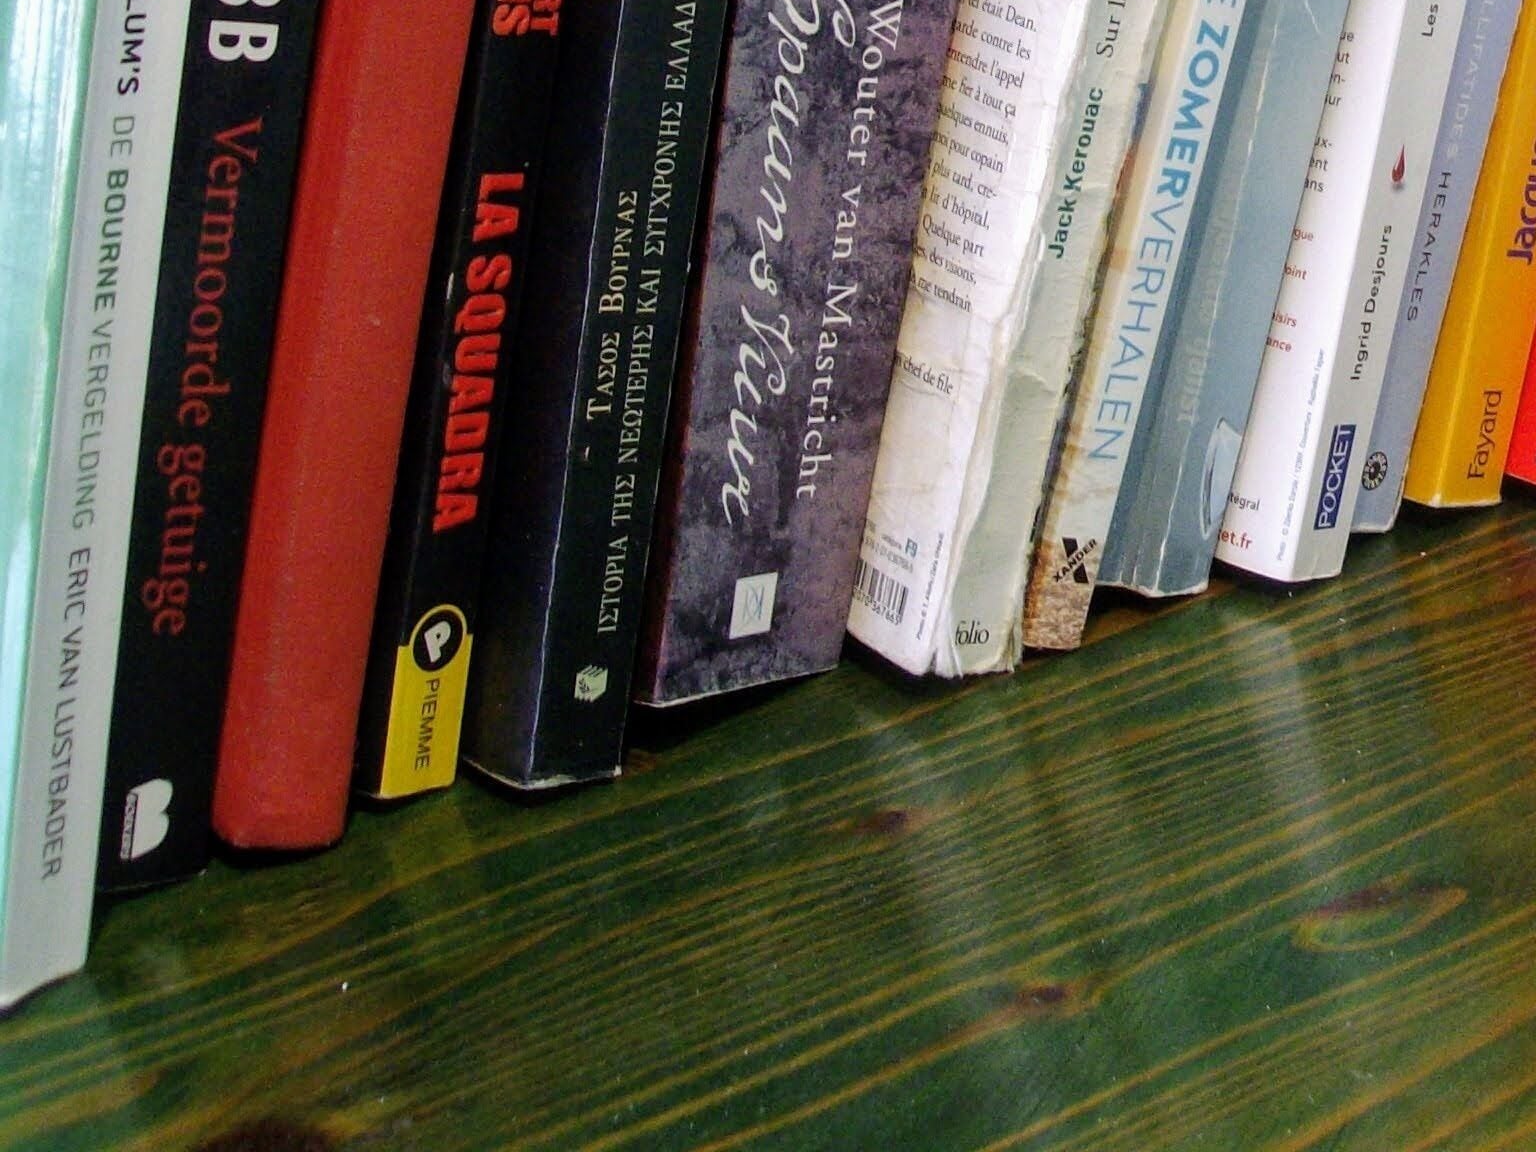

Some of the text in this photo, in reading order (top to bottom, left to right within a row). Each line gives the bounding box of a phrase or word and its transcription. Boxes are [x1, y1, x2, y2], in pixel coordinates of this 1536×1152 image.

[1005, 5, 1037, 32] Dean.
[1097, 20, 1121, 58] Sur
[1421, 3, 1440, 38] Les
[111, 115, 135, 151] DE
[644, 101, 682, 255] ΣΥΓΧΡΟΝΗΣ
[1048, 87, 1104, 259] Jack Kerouac
[92, 170, 127, 312] BOURNE
[831, 185, 862, 261] van
[1088, 25, 1230, 462] ZOMERVERHALEN
[1406, 171, 1451, 322] HERAKLES
[587, 190, 638, 421] ΤΑΣΟΣ ΒΟΥΡΝΑΣ
[636, 270, 660, 313] ΚΑΙ
[1350, 225, 1392, 381] Ingrid Desjours
[141, 117, 263, 638] Vermoorde getuige
[433, 172, 524, 535] LA SQUADRA
[619, 325, 654, 463] ΝΕΩΤΕΡΗΣ
[796, 283, 859, 499] Mastricht
[70, 321, 113, 528] VERGELDING
[1467, 390, 1502, 479] Fayard
[611, 474, 635, 527] ΤΗΣ
[1318, 426, 1352, 529] POCKET
[64, 550, 90, 618] ERIC
[598, 536, 628, 633] ΙΣΤΟΡΙΑ
[1052, 538, 1099, 583] XANDER
[58, 629, 82, 687] VAN
[955, 620, 990, 646] folio
[415, 678, 441, 770] PIEMME
[41, 696, 75, 880] LUSTBADER
